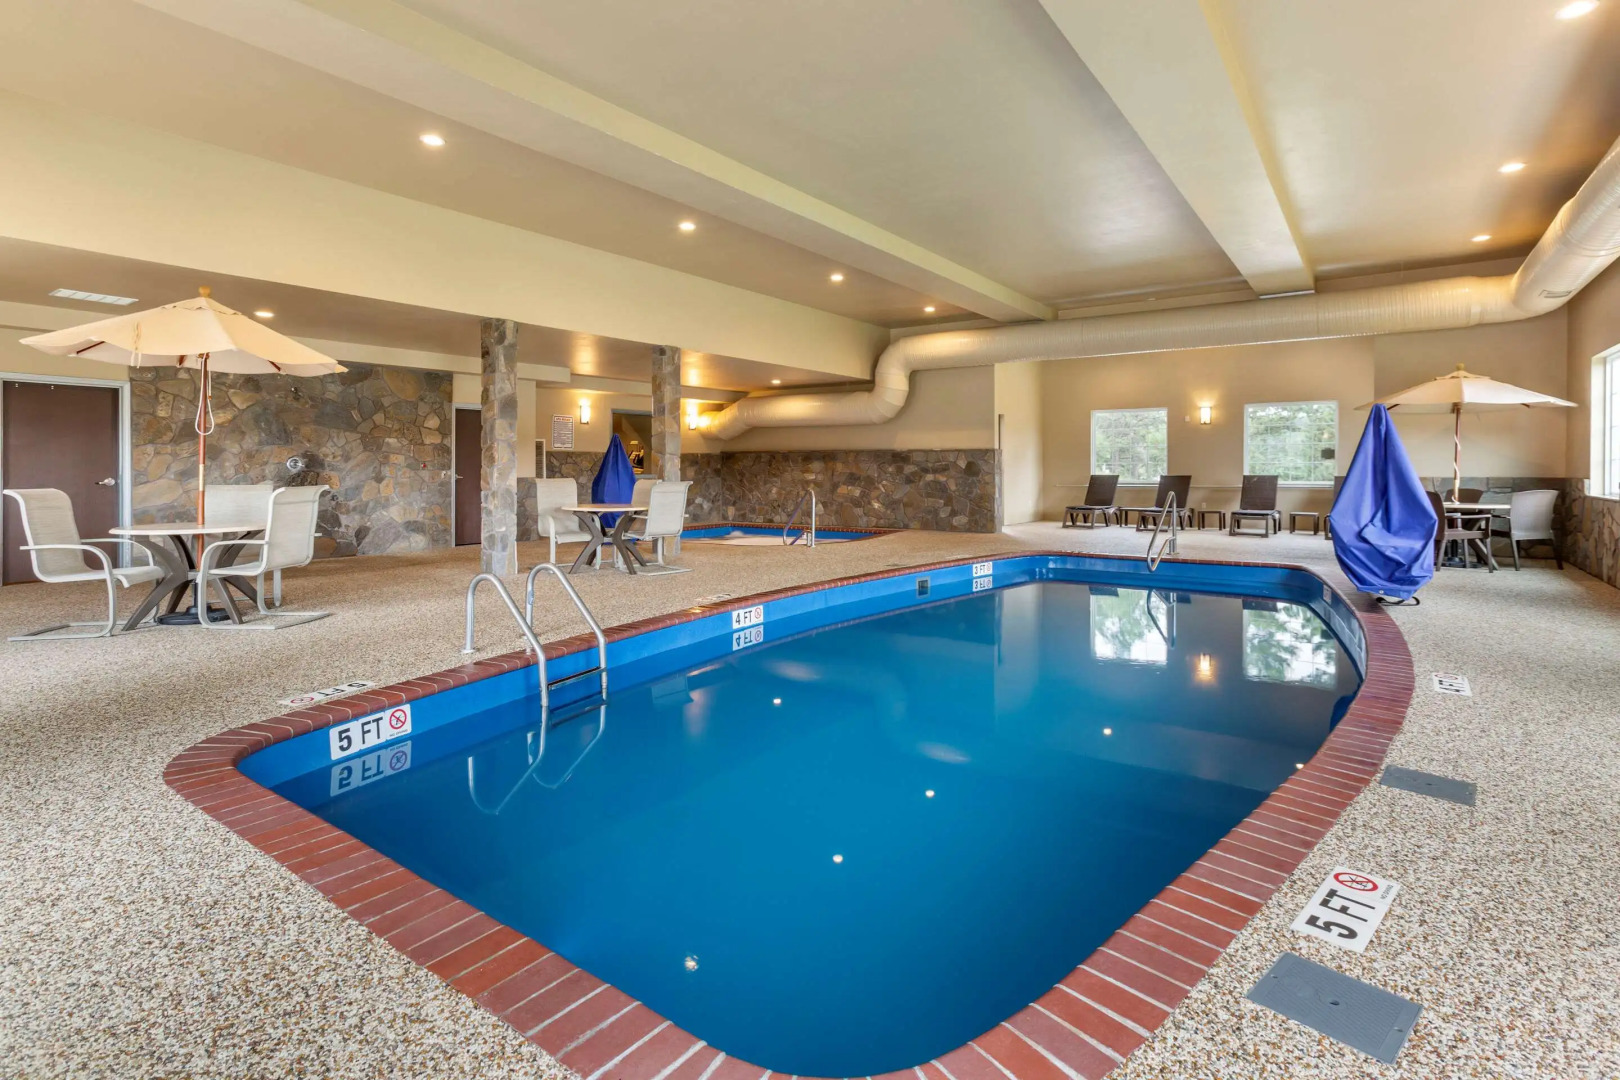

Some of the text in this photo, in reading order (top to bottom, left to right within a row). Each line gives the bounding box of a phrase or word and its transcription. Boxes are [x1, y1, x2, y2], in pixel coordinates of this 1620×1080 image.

[979, 564, 986, 574] FT
[735, 610, 753, 626] 4 FT
[338, 716, 384, 753] 5 FT
[1304, 888, 1376, 940] 5 FT
